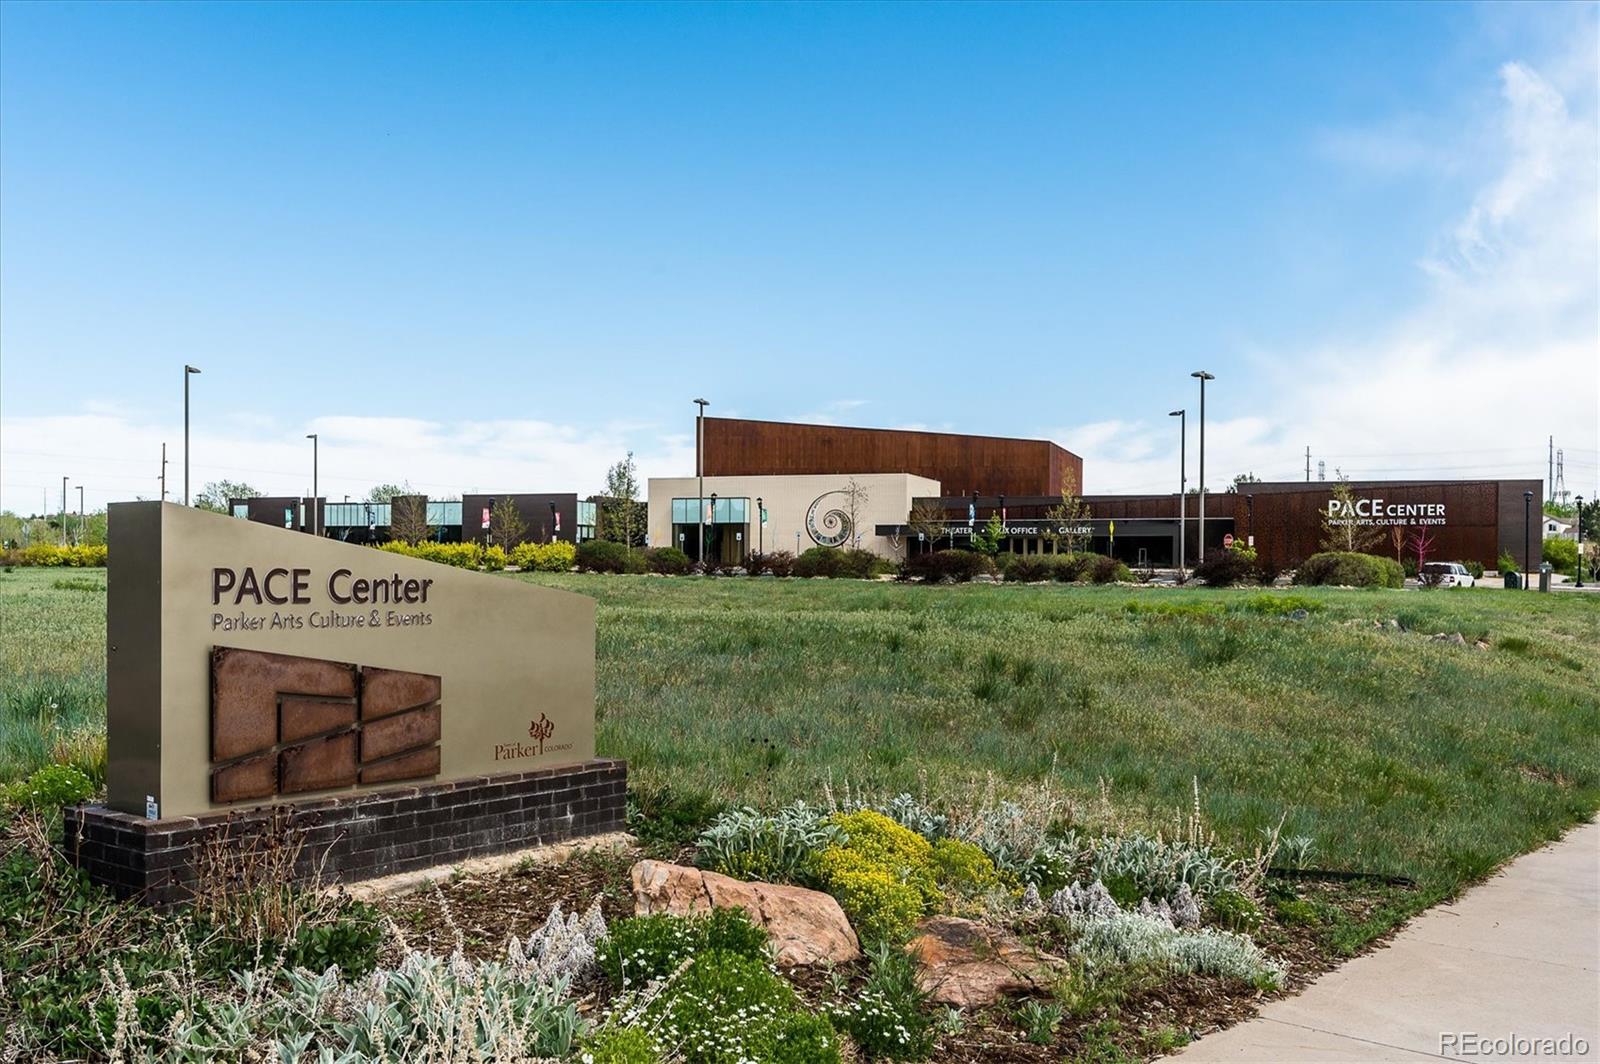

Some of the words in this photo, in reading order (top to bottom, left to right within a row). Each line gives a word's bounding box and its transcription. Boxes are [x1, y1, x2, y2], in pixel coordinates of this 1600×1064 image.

[1328, 499, 1384, 517] PACE
[1386, 504, 1445, 516] CENTER
[212, 568, 311, 605] PACE
[328, 569, 433, 604] Center
[212, 612, 266, 631] Parker
[270, 613, 304, 630] Arts
[310, 610, 365, 629] Culture
[368, 610, 381, 627] &
[387, 610, 433, 627] Events
[495, 742, 538, 760] Parker
[544, 744, 573, 752] COLORADO
